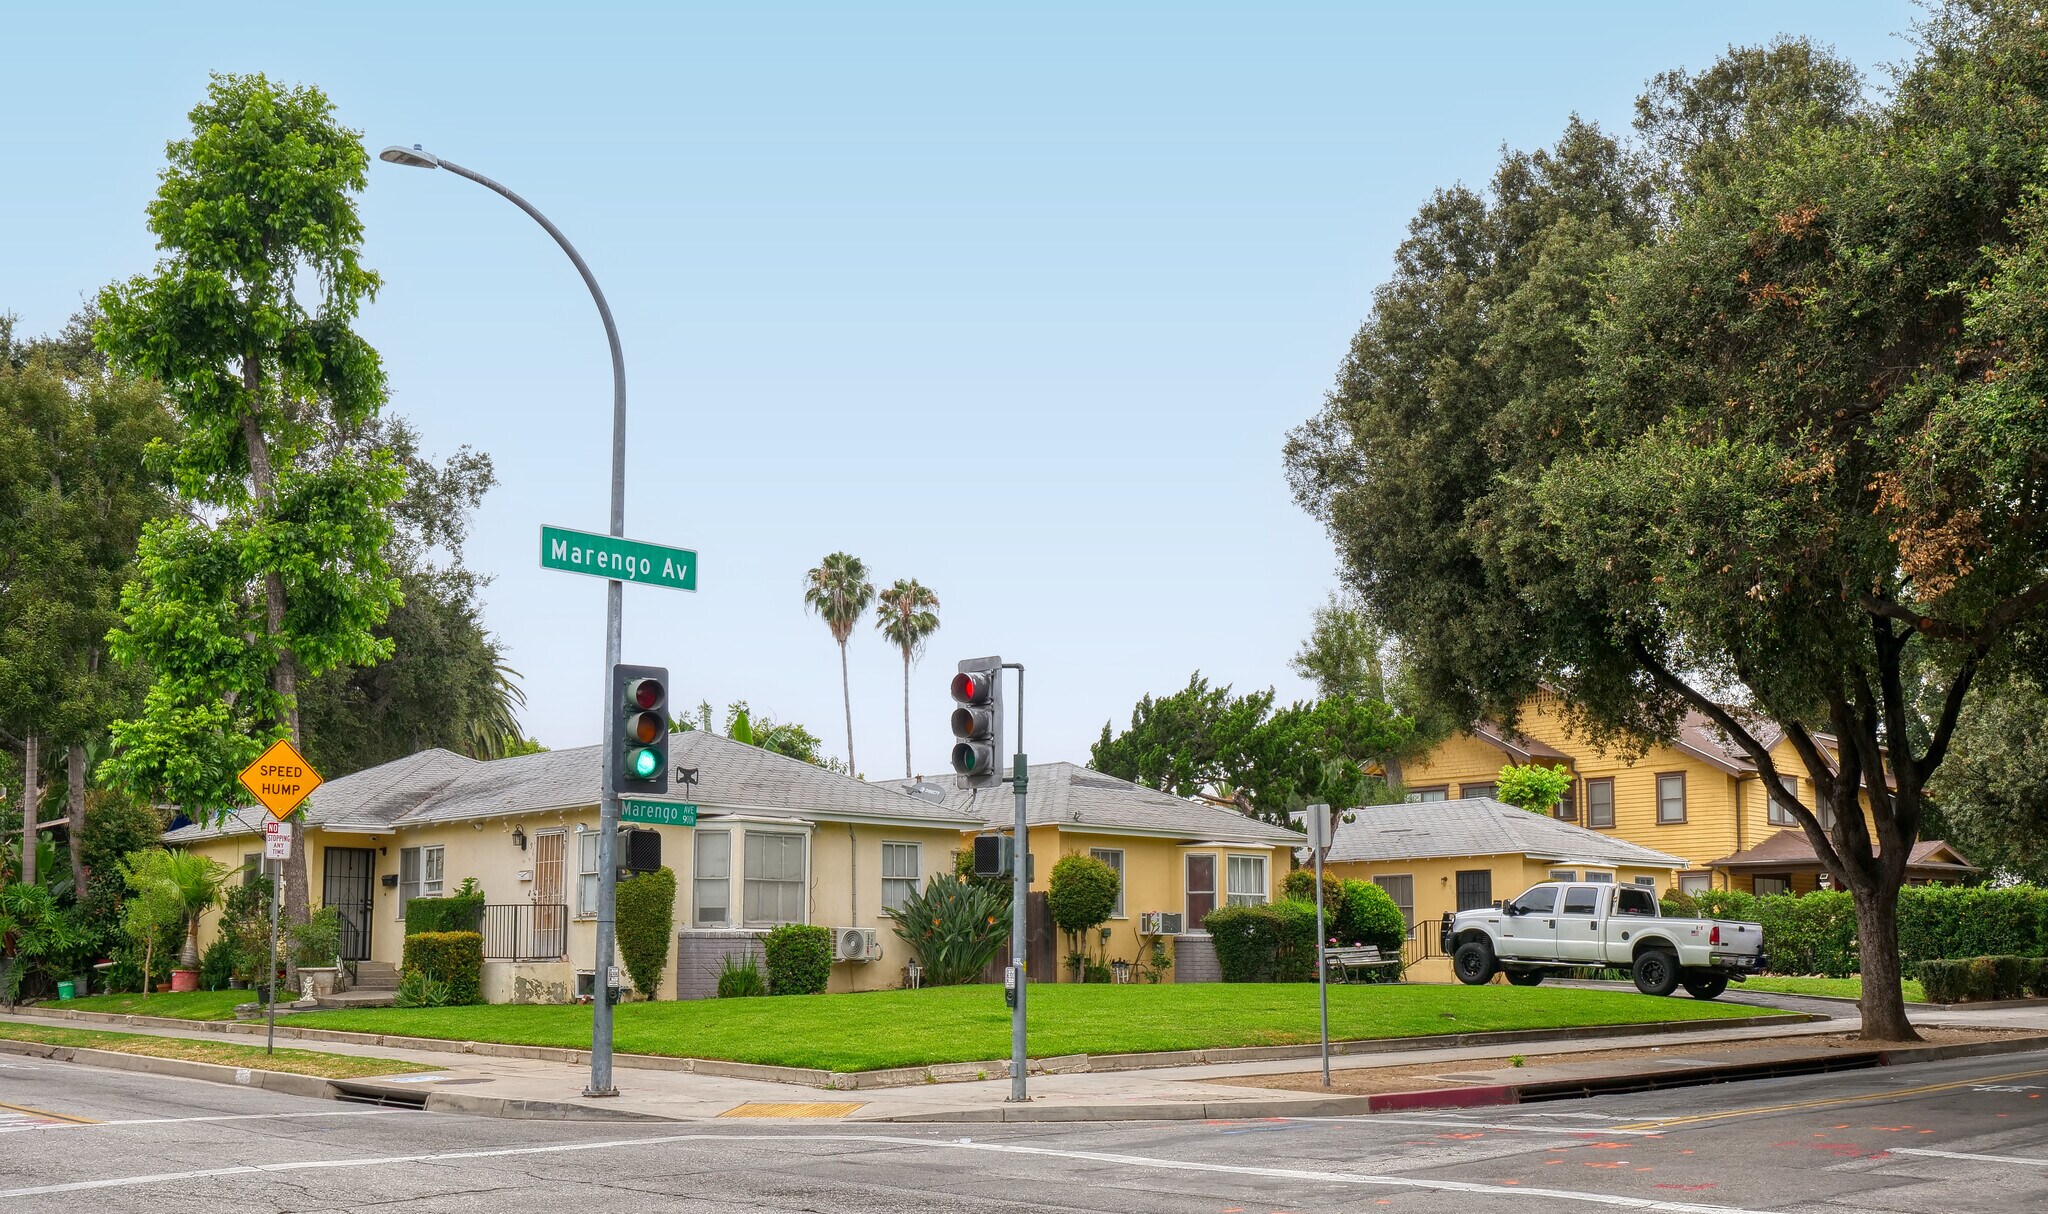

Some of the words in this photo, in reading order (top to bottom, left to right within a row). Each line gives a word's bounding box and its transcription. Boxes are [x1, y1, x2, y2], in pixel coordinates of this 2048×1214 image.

[551, 538, 650, 579] Marengo
[662, 557, 688, 581] Av
[260, 765, 302, 778] SPEED
[262, 783, 300, 796] HUMP
[621, 800, 678, 823] Marengo
[683, 806, 694, 815] AVE
[269, 824, 278, 833] NO
[267, 834, 291, 843] STOPPING
